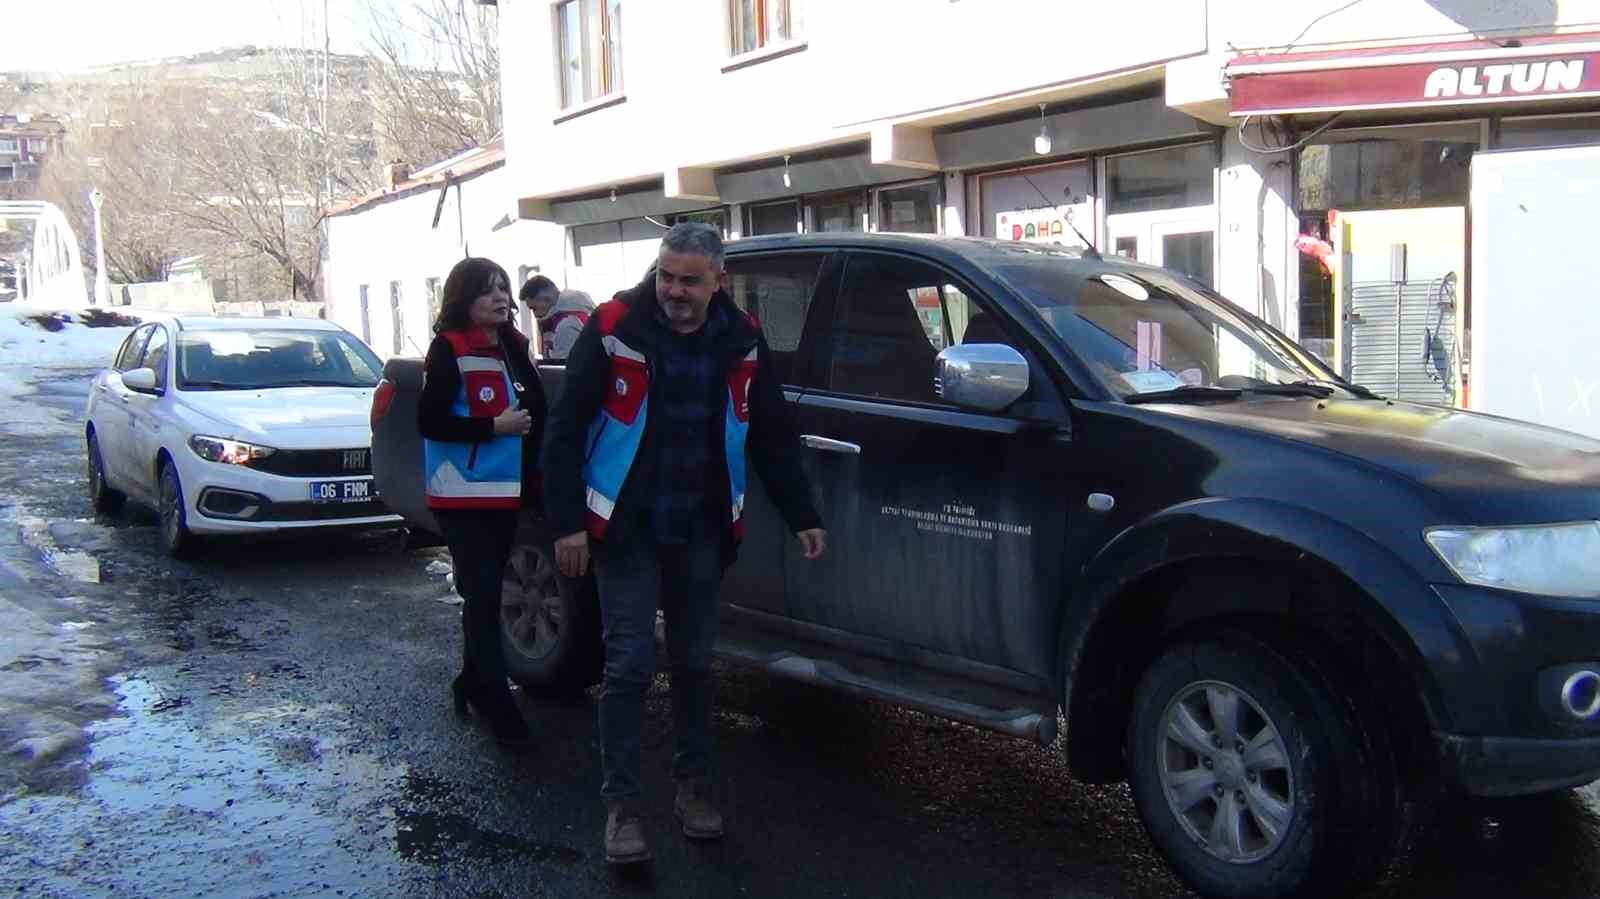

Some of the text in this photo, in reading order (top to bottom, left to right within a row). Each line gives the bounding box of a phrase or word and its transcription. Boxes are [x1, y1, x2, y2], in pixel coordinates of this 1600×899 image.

[1424, 60, 1585, 98] ALTUN
[343, 450, 367, 469] FIAT
[320, 483, 337, 499] 06
